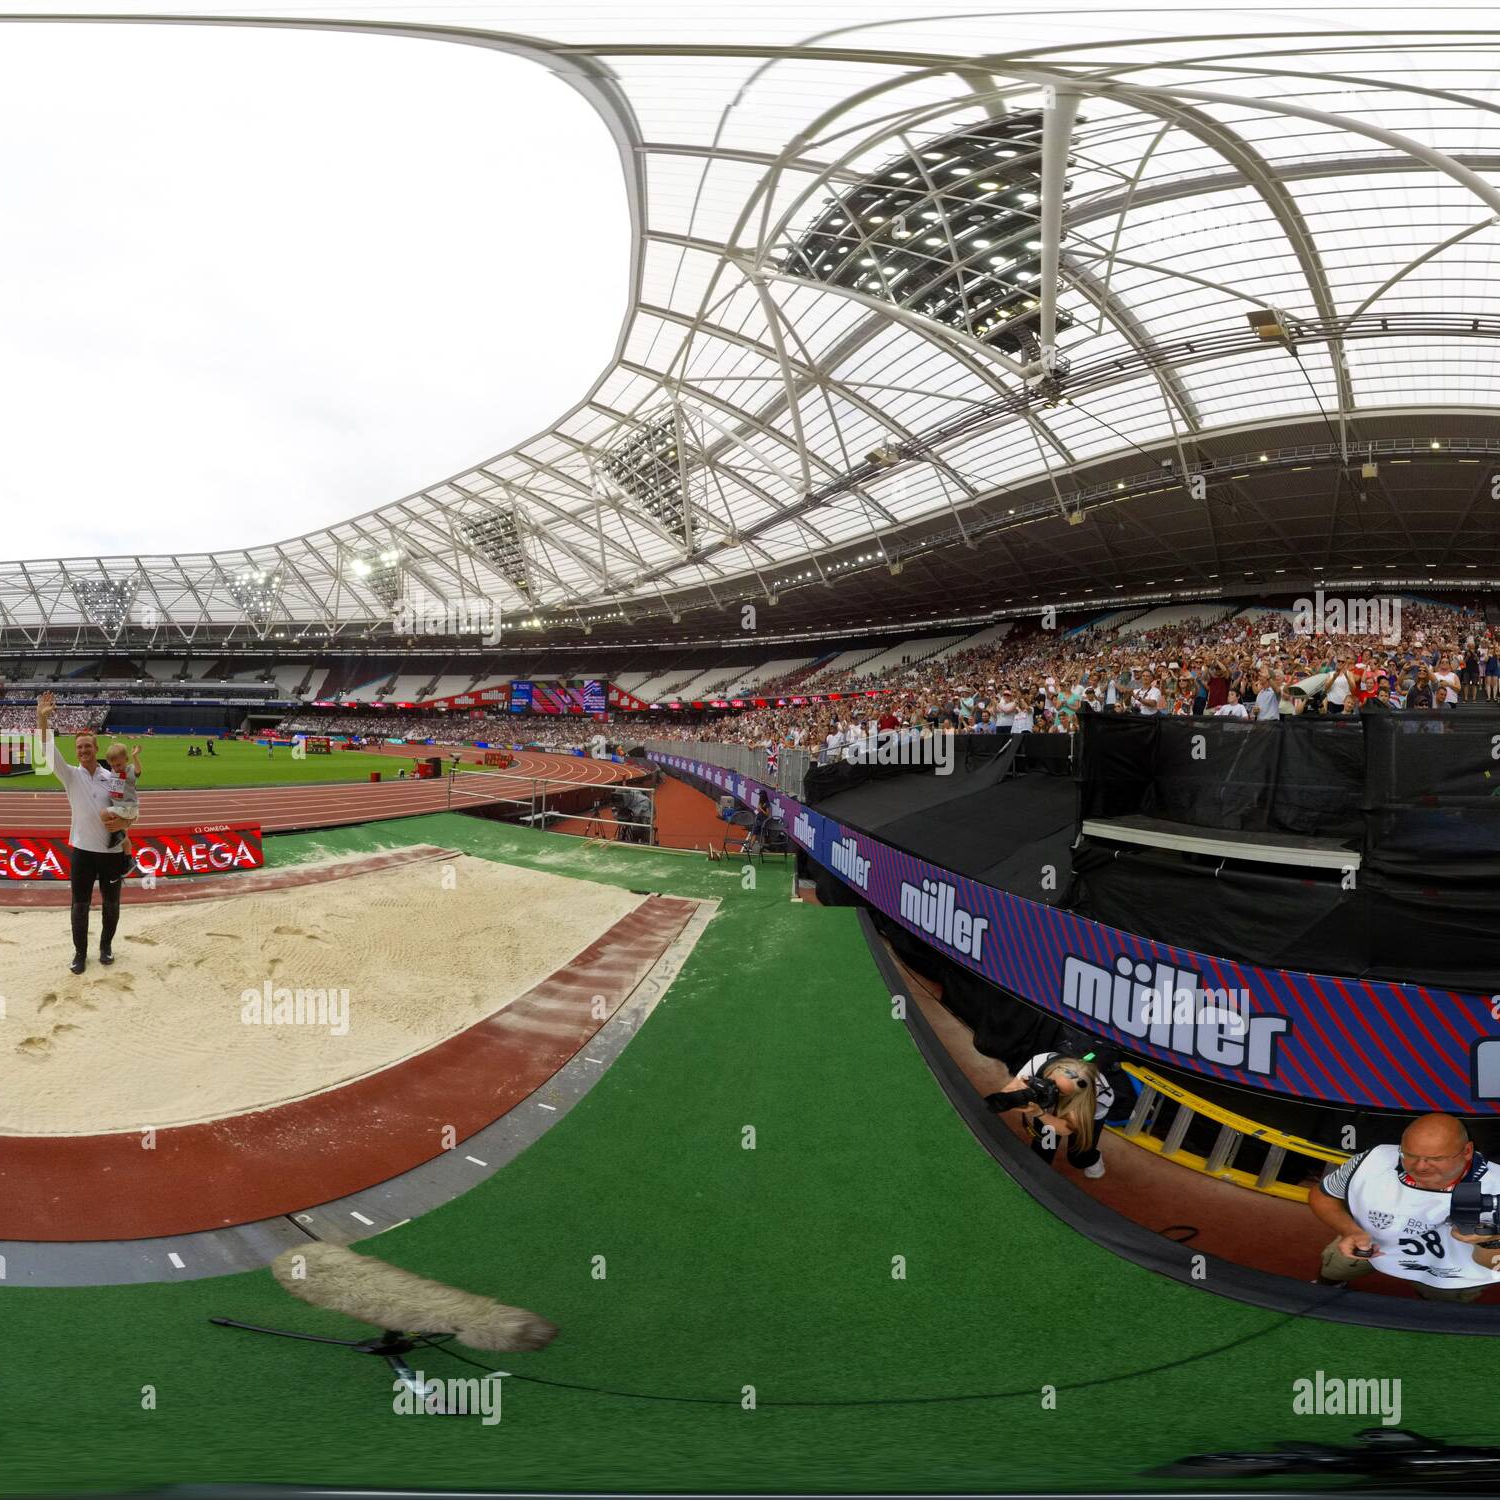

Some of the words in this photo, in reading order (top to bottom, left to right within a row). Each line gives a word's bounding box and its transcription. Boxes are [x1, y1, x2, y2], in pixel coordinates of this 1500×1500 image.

[136, 840, 257, 874] OMEGA
[831, 838, 871, 891] müller
[900, 879, 989, 961] müller
[1062, 956, 1287, 1075] müller
